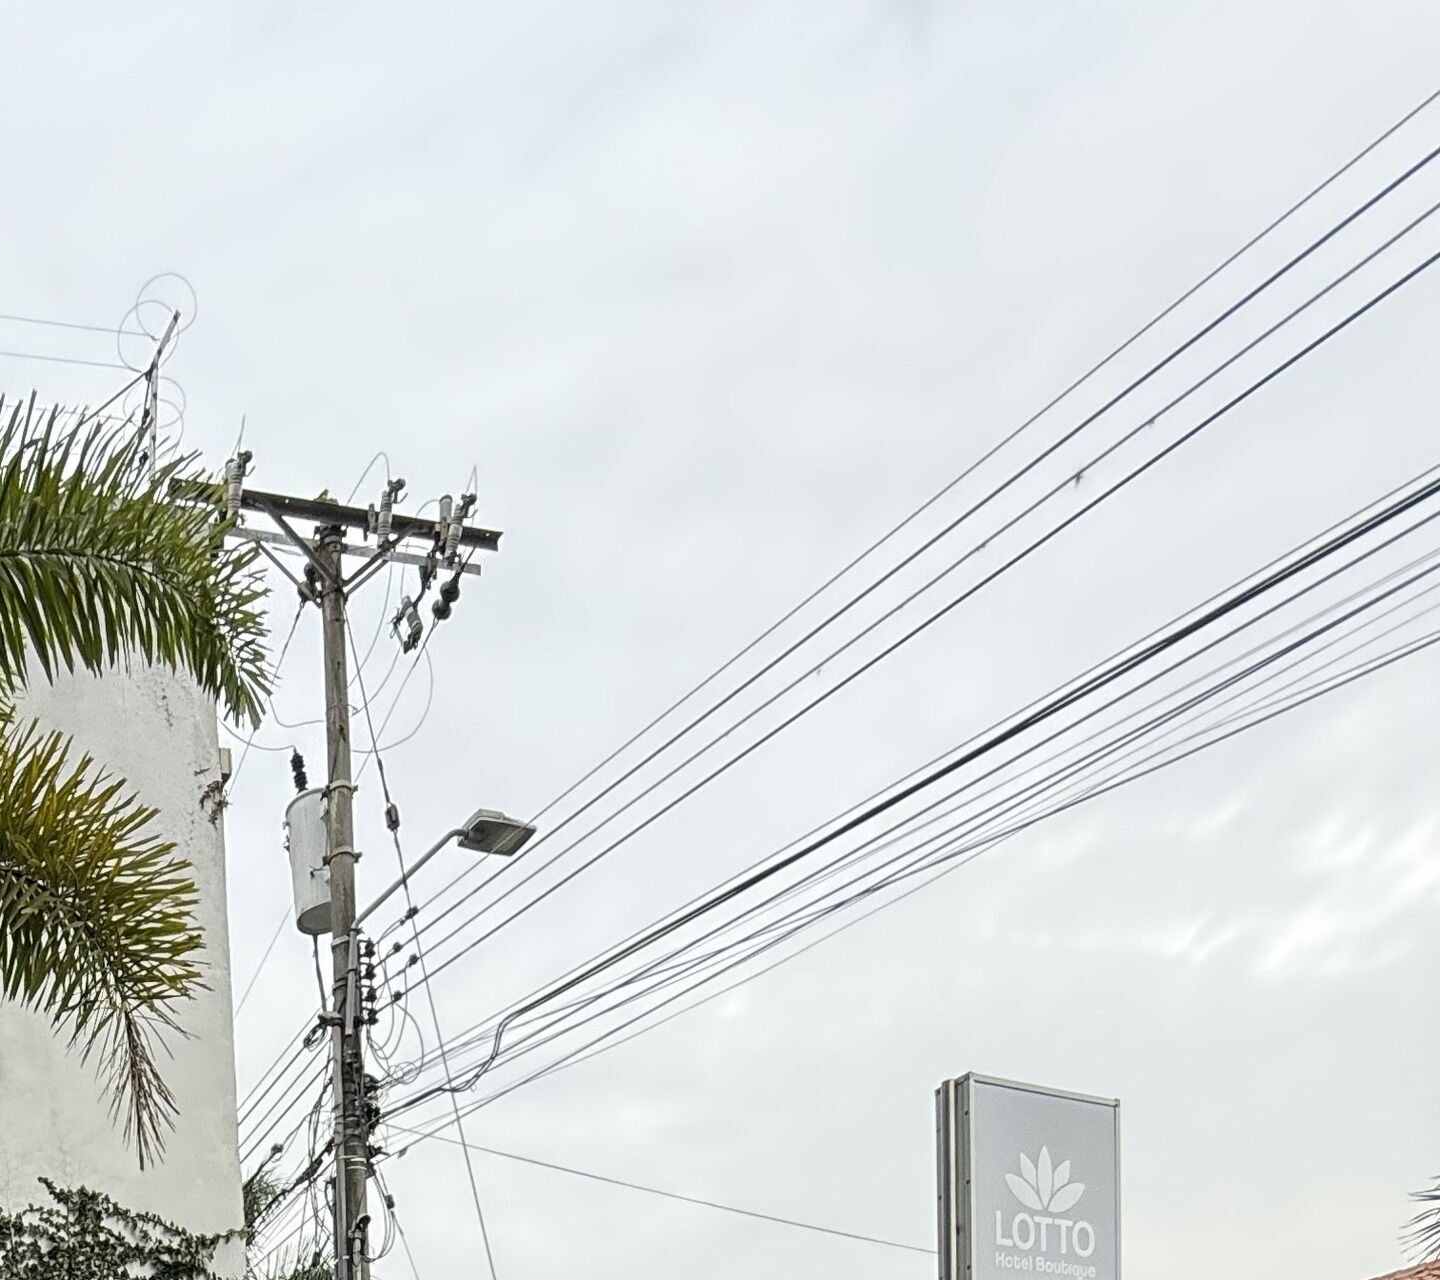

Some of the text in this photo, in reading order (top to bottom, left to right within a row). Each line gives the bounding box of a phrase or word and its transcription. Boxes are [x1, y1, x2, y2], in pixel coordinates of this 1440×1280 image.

[995, 1210, 1095, 1258] LOTTO
[995, 1252, 1097, 1280] Hotel Boutique
